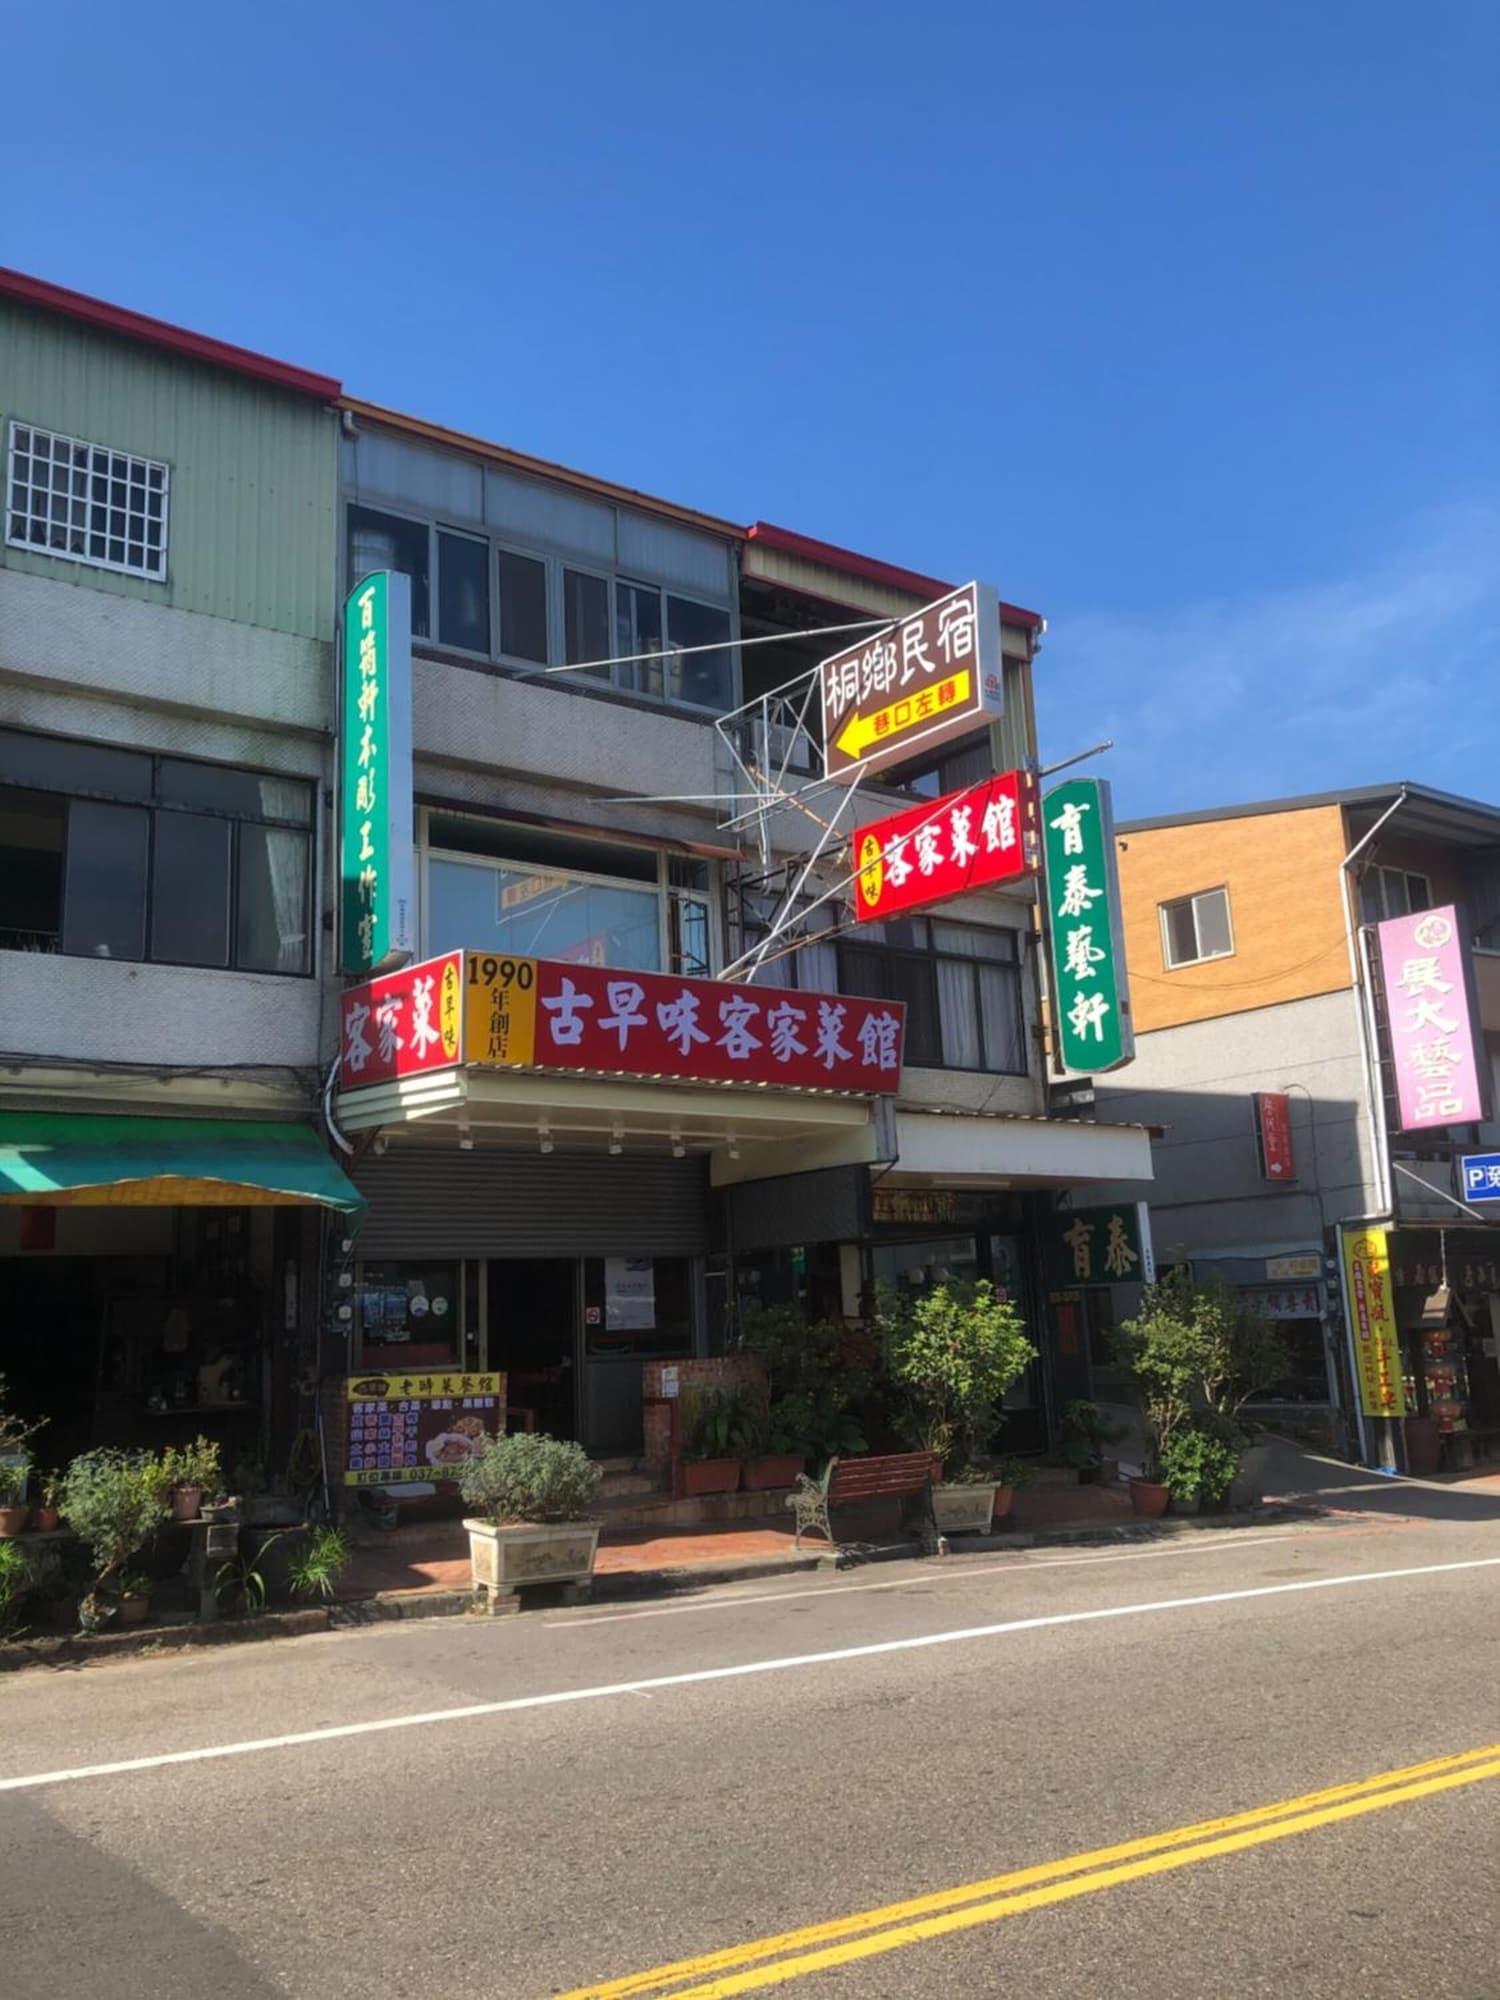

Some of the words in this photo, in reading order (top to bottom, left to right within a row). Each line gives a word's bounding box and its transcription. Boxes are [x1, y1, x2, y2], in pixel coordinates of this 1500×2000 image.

[826, 599, 975, 719] 桐鄉民宿
[873, 681, 958, 737] 巷口左轉
[883, 794, 1017, 888] 客家菜館
[1050, 803, 1110, 1043] 育泰藝軒
[469, 956, 534, 990] 1990
[344, 975, 440, 1072] 客家菜
[489, 988, 510, 1058] 年創店
[542, 978, 901, 1071] 古早味客家菜館
[1395, 956, 1464, 1120] 展大藝品
[1063, 1214, 1138, 1279] 育泰
